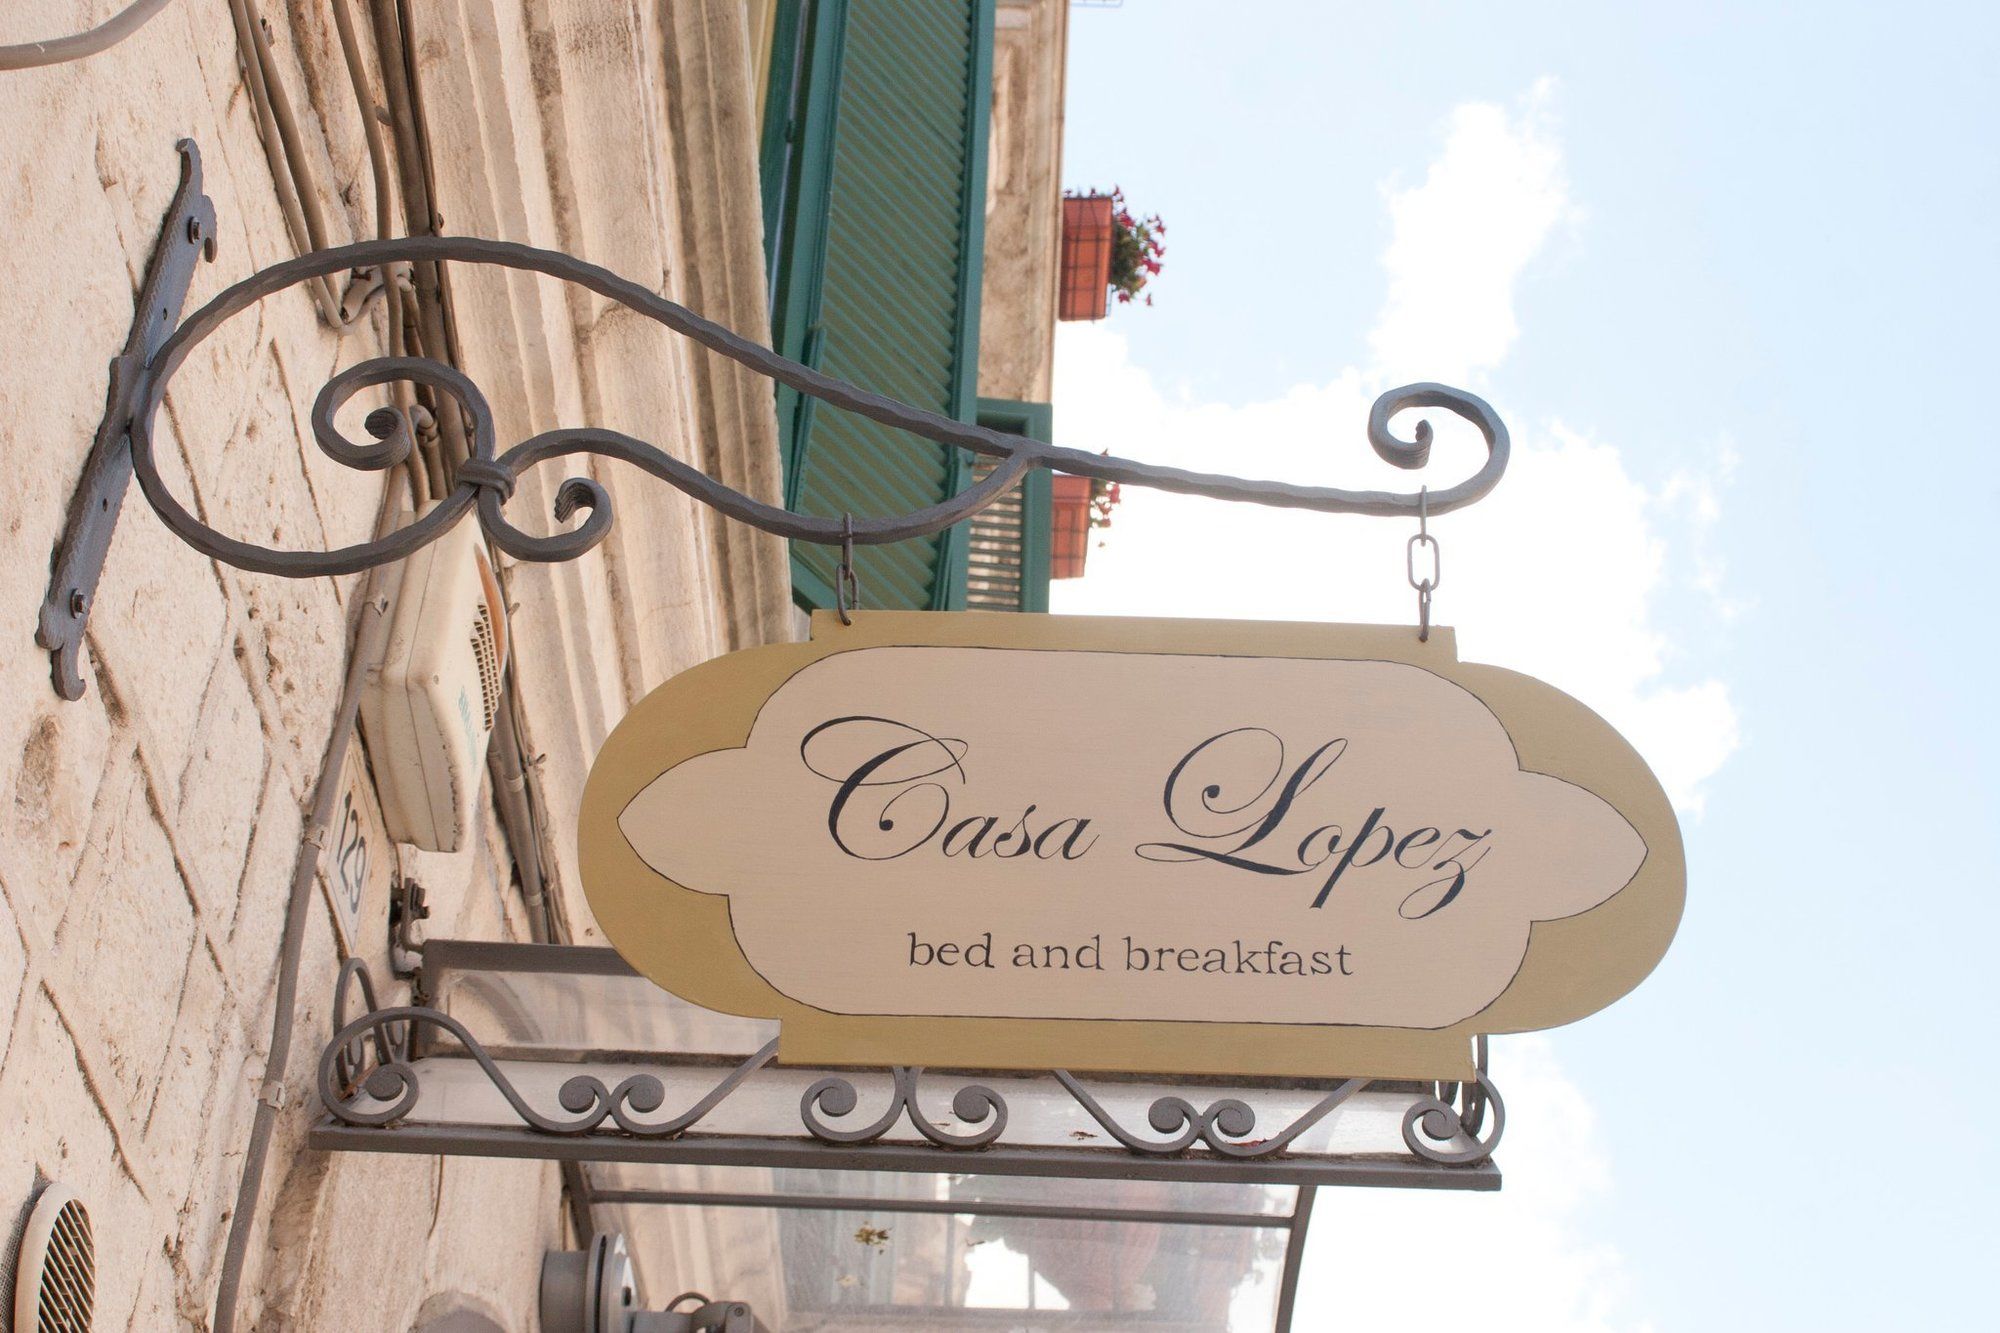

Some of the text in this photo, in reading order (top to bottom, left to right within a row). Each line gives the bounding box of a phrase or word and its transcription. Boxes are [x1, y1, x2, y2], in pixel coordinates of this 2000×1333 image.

[336, 789, 367, 914] 129
[800, 716, 1492, 920] Casa Lopez
[907, 932, 1353, 977] bed and breakfast
